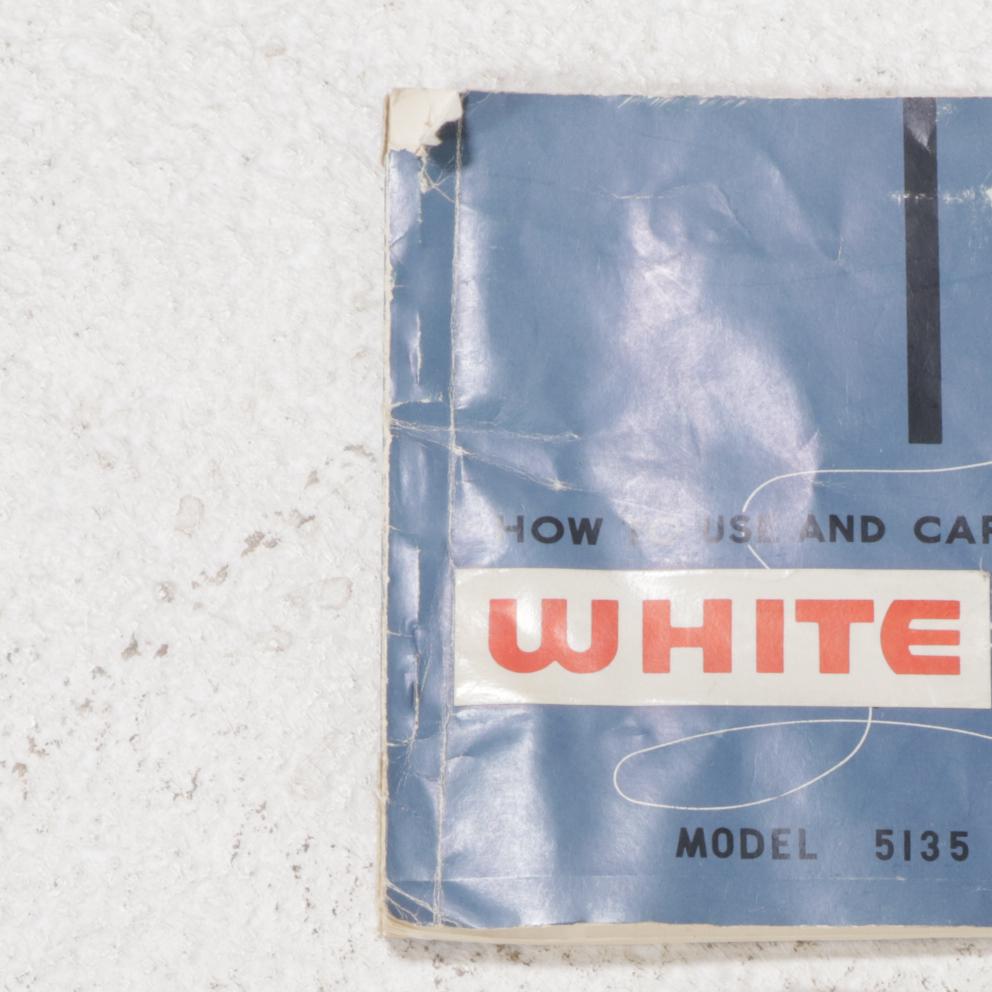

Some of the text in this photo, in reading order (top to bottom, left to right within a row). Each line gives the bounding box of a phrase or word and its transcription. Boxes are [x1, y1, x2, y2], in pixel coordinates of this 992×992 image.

[501, 514, 603, 546] HOW
[806, 515, 886, 545] AND
[488, 598, 960, 675] WHITE
[675, 827, 969, 861] MODEL 5135
